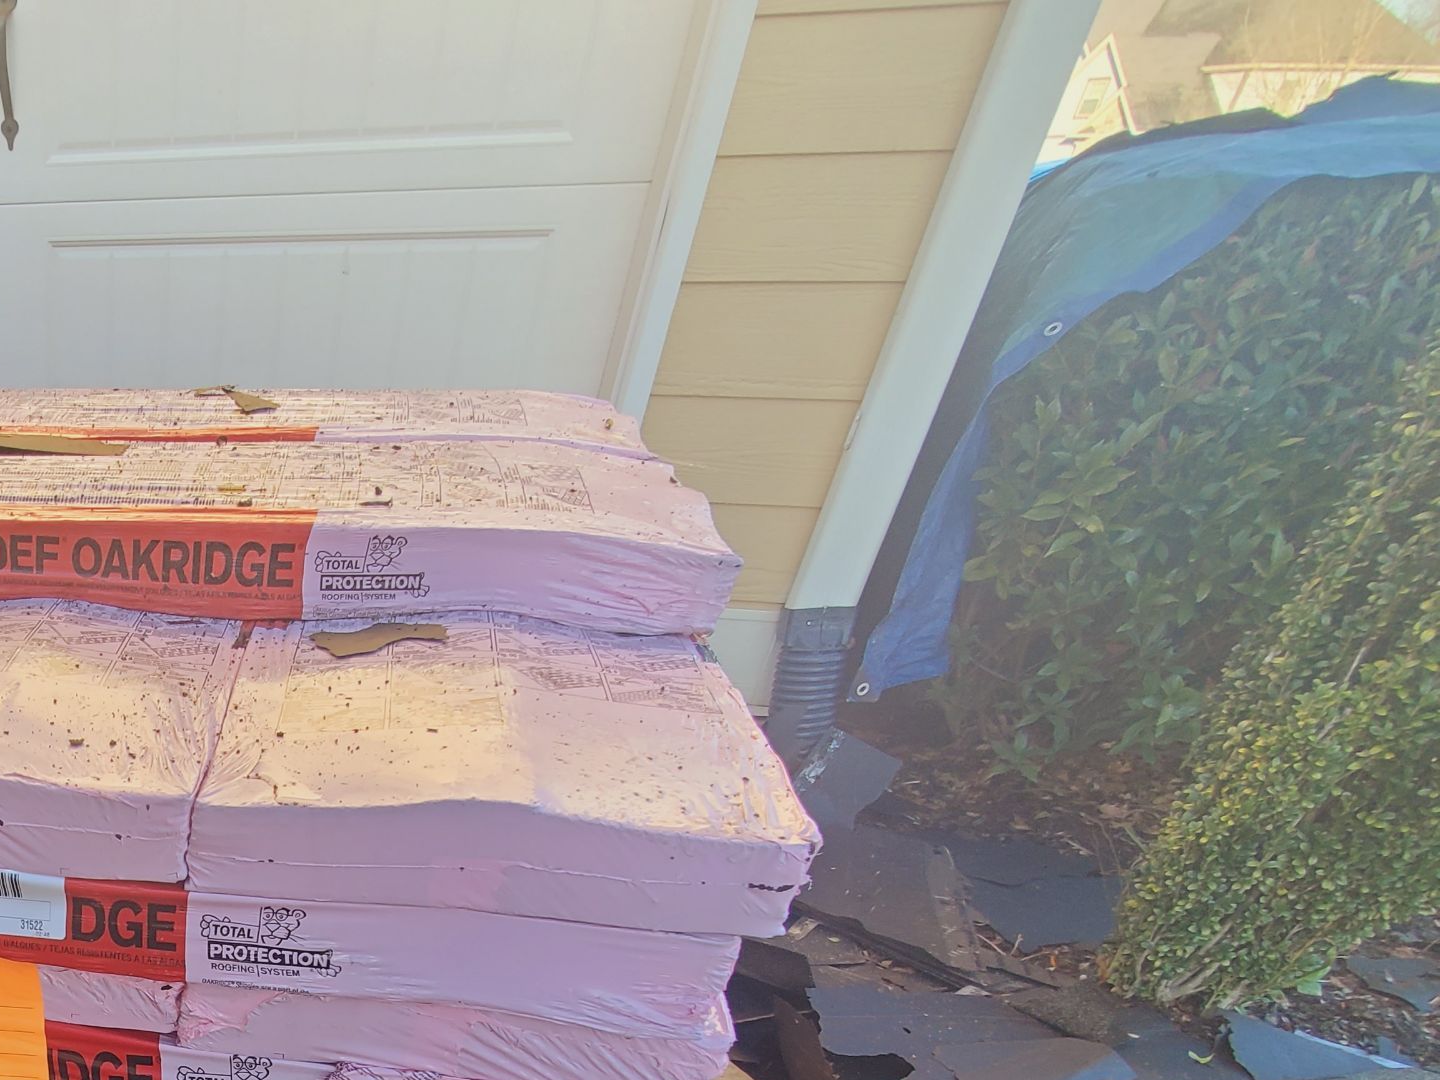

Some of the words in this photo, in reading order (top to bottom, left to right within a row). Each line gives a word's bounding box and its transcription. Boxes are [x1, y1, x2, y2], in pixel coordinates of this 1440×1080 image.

[72, 536, 297, 589] OAKRIDGE
[325, 559, 360, 570] TOTAL
[321, 575, 420, 590] PROTECTION
[322, 592, 360, 600] ROOFING
[365, 592, 396, 600] SYSTEM
[20, 919, 44, 931] 31522
[213, 923, 254, 939] TOTAL
[210, 943, 330, 969] PROTECTION
[211, 963, 255, 974] ROOFING
[260, 966, 300, 977] SYSTEM
